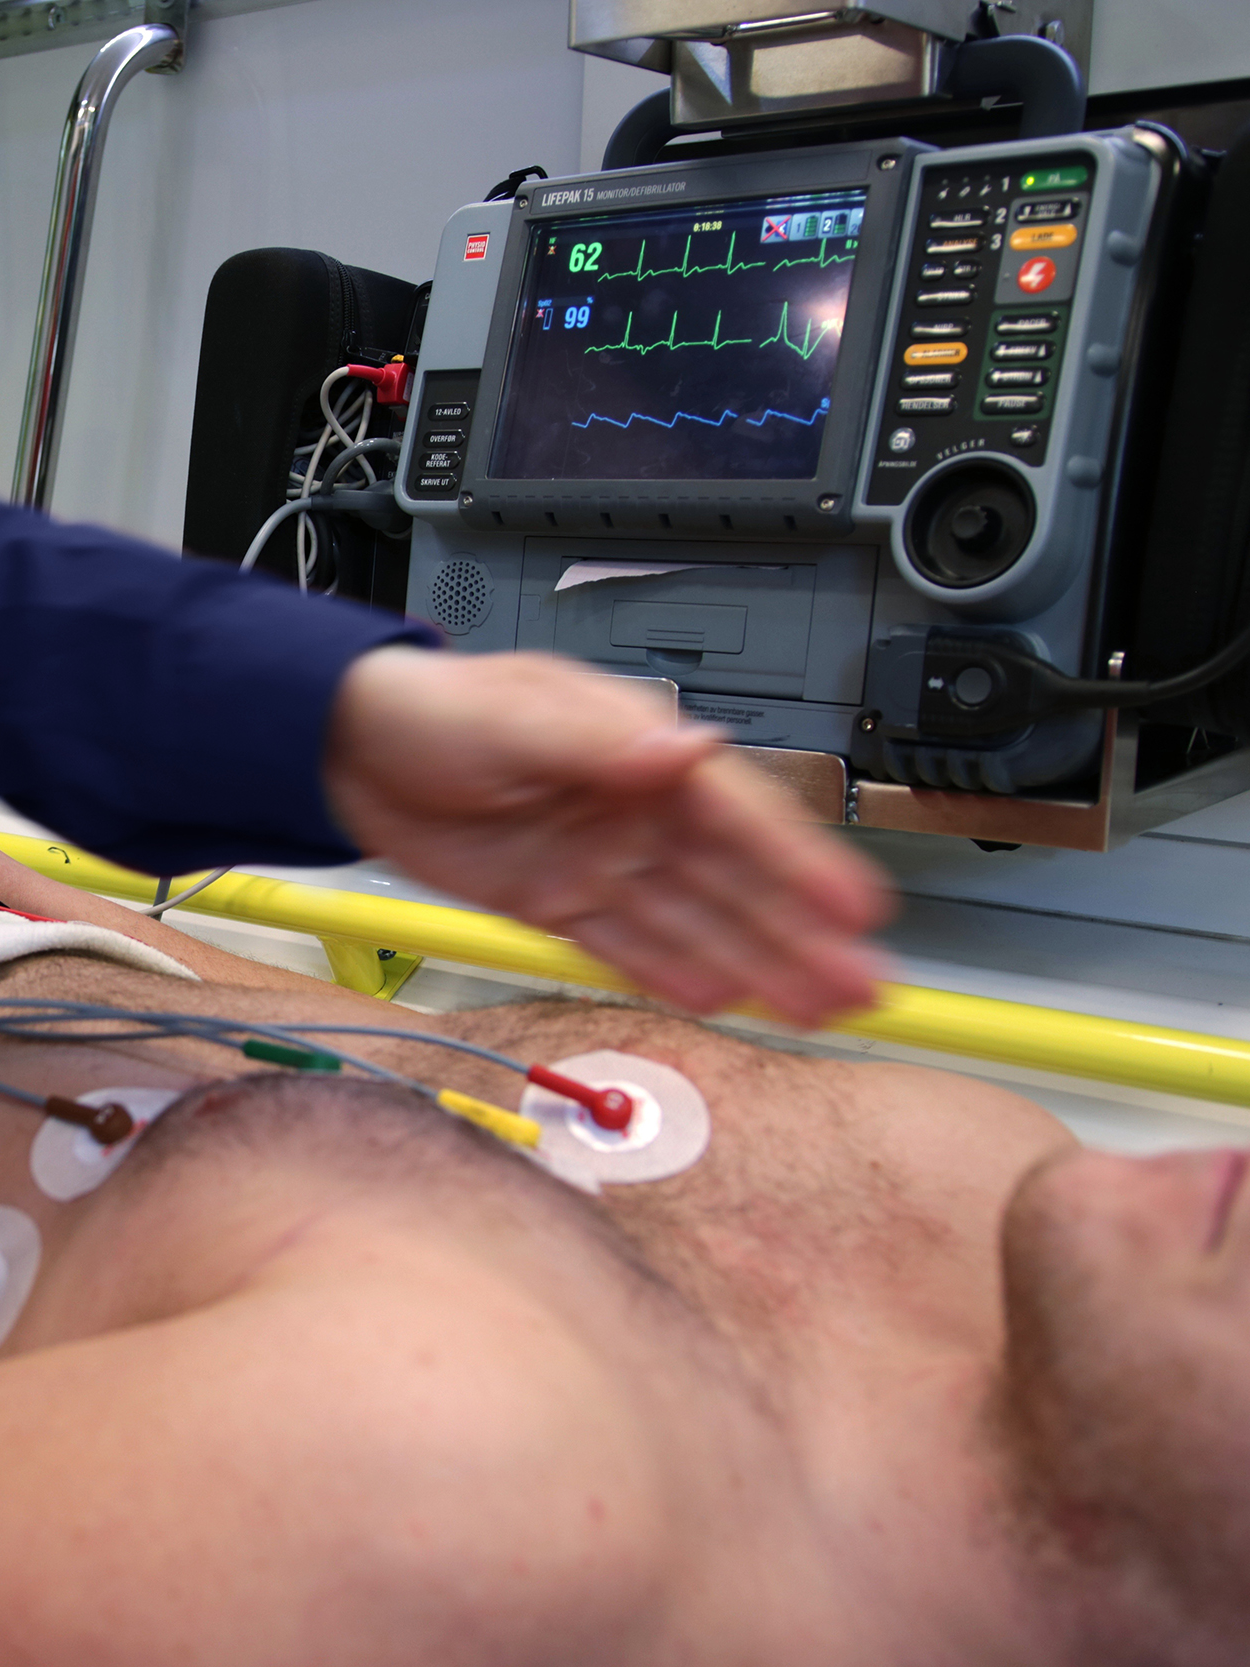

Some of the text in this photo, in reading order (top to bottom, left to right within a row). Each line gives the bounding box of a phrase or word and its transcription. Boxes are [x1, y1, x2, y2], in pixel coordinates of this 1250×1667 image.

[541, 181, 687, 207] LIFEPAK 15 MONITOR/DEFIBRILLATOR
[995, 207, 1007, 224] 2
[823, 218, 832, 232] 2
[990, 233, 1002, 250] 3
[568, 242, 603, 273] 62
[563, 305, 590, 330] 99
[435, 408, 461, 416] 12-AVLED
[430, 435, 456, 443] OVERFØR
[936, 438, 986, 460] VELGER
[426, 460, 451, 468] REFERAT
[431, 453, 448, 461] KODE-
[420, 478, 450, 486] SKRIVE UT
